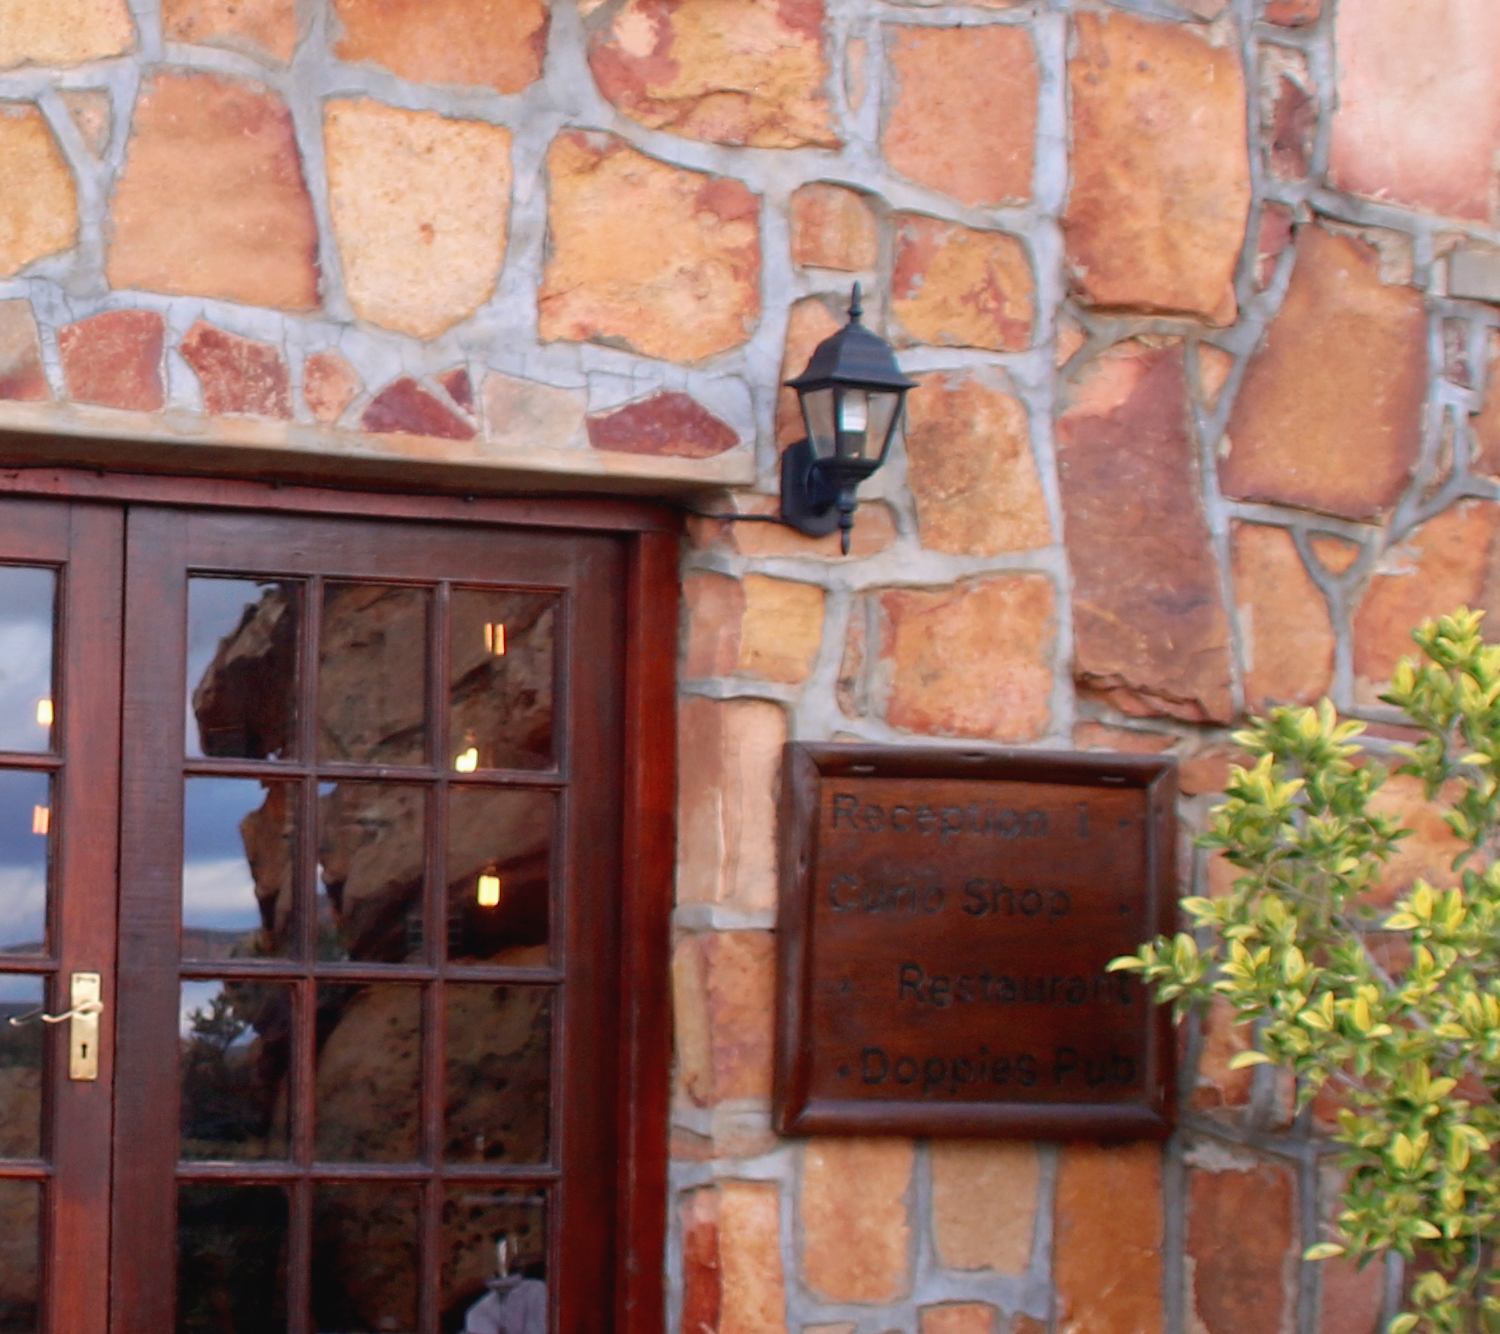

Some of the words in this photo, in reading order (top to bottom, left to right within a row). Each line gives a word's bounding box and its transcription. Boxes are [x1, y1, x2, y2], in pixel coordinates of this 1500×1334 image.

[831, 791, 1048, 844] Reception
[828, 873, 947, 915] Curio
[961, 876, 1073, 923] Shop
[898, 961, 1134, 1008] Restaurant
[860, 1044, 1039, 1095] Doppies
[1053, 1045, 1139, 1088] Pub
